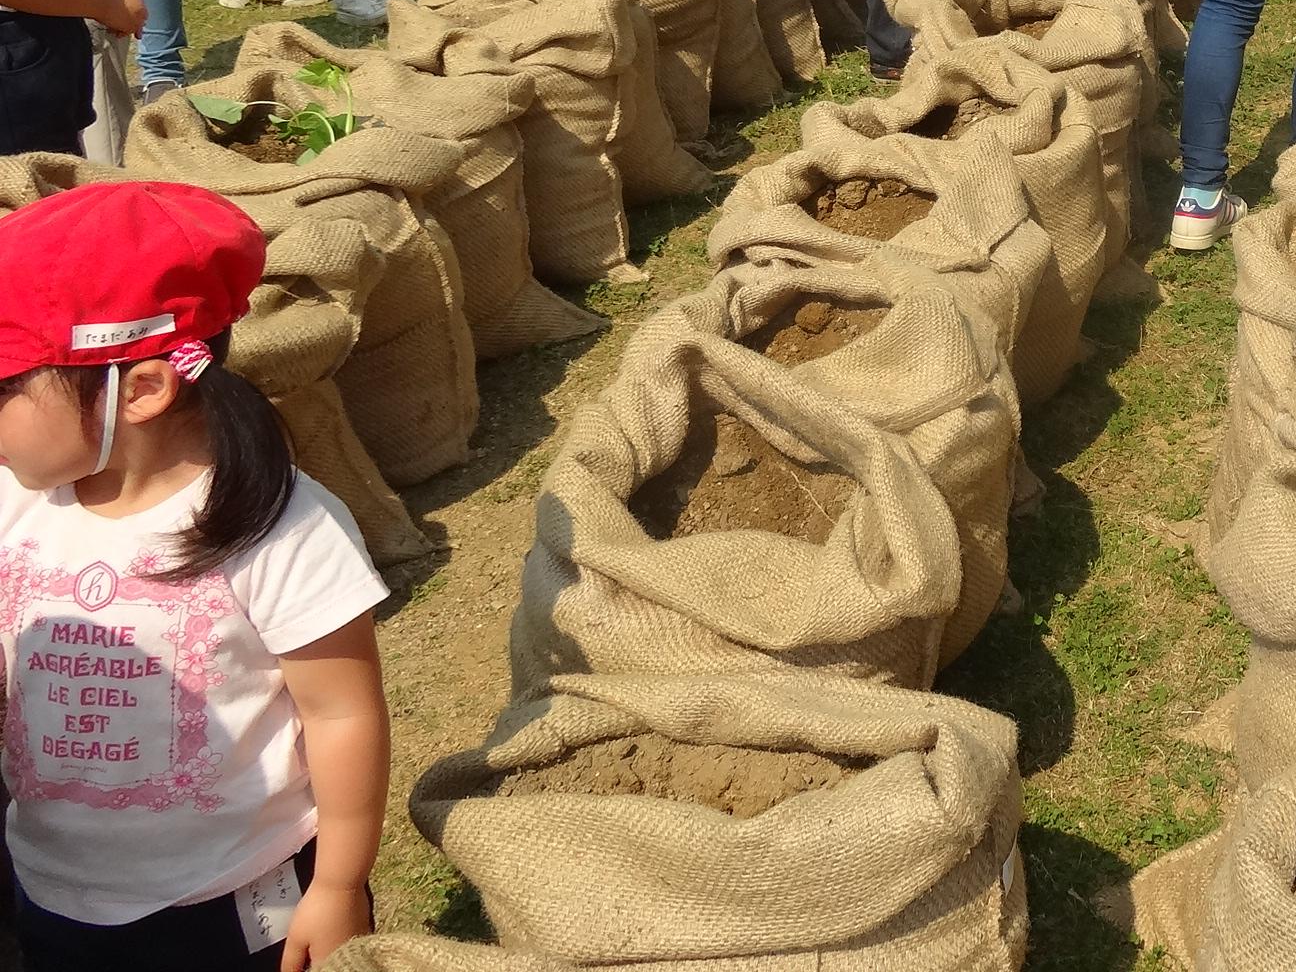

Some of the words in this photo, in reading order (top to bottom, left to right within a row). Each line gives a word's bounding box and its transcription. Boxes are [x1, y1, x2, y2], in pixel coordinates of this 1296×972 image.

[51, 623, 136, 648] MARIE
[28, 652, 162, 679] AGRÉABLE
[48, 683, 70, 705] LE
[80, 687, 137, 707] CIEL
[64, 714, 110, 733] EST
[42, 735, 140, 762] DÉGAGÉ
